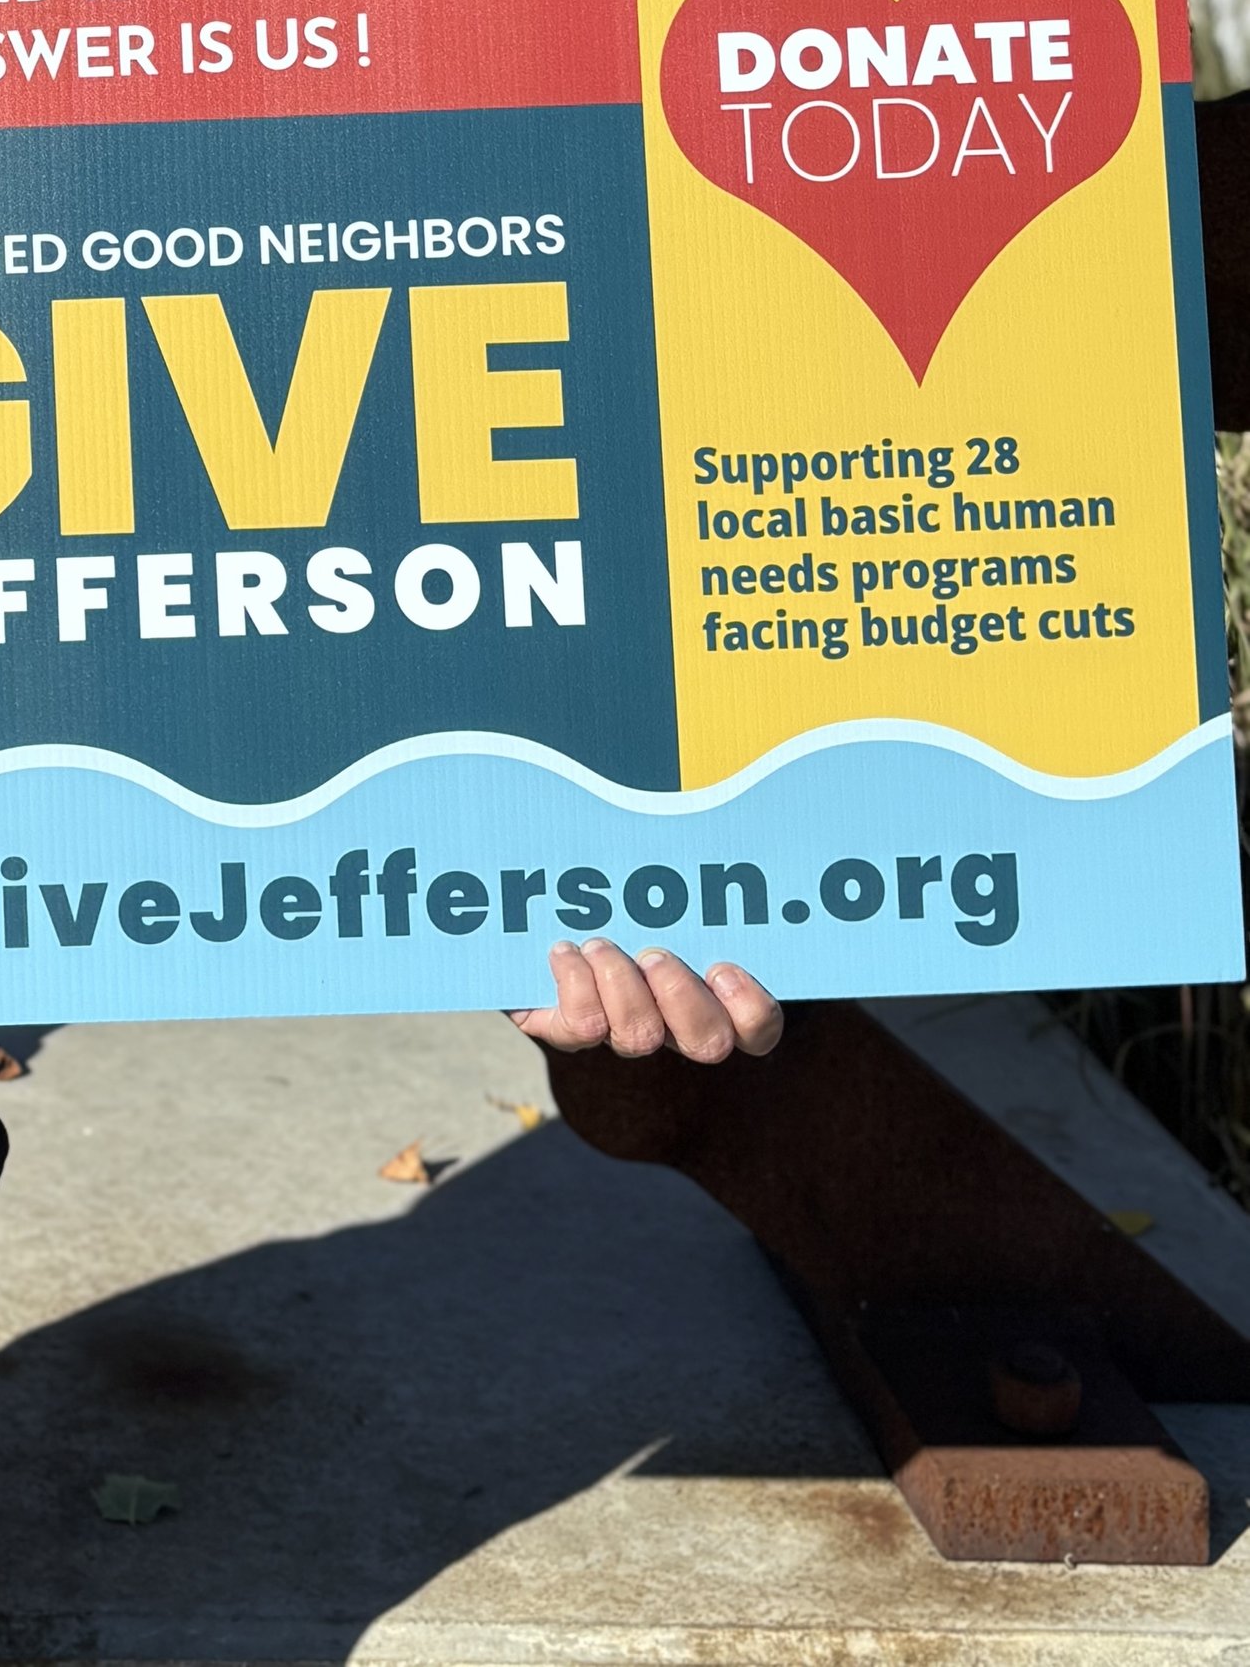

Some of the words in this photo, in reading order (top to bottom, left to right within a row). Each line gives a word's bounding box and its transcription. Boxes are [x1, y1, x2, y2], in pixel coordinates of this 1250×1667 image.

[180, 20, 234, 74] IS
[716, 19, 1074, 93] DONATE
[720, 91, 1073, 184] TODAY
[82, 226, 244, 271] GOOD
[259, 214, 566, 265] NEIGHBORS
[693, 438, 955, 494] Supporting
[965, 436, 1020, 476] 28
[696, 498, 808, 541] local
[821, 493, 940, 537] basic
[953, 492, 1116, 533] human
[701, 553, 839, 596] needs
[852, 553, 1077, 603] programs
[703, 610, 849, 660] facing
[861, 604, 1027, 656] budget
[1038, 603, 1136, 639] cuts
